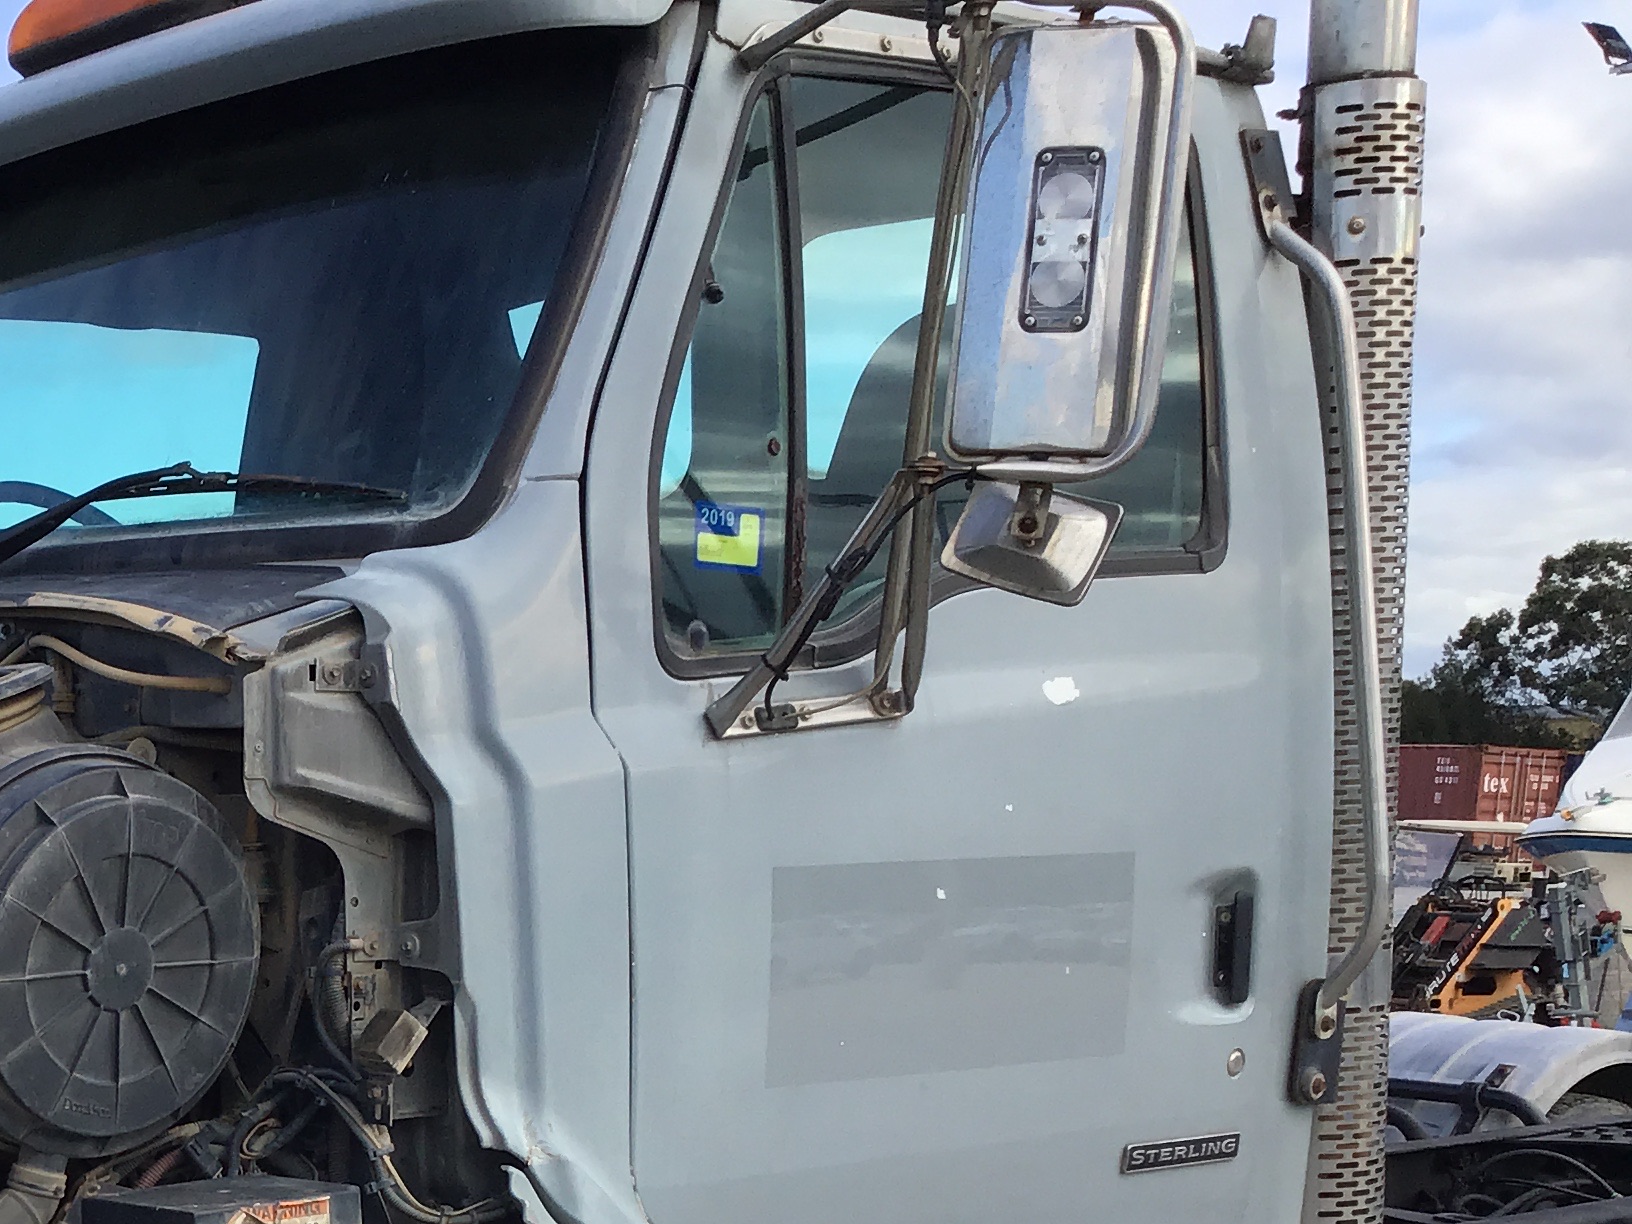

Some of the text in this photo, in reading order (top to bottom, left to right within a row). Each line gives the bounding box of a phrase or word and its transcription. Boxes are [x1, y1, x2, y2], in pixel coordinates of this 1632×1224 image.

[701, 507, 735, 527] 2019
[1483, 773, 1509, 793] tex
[1131, 1138, 1236, 1166] STERLING
